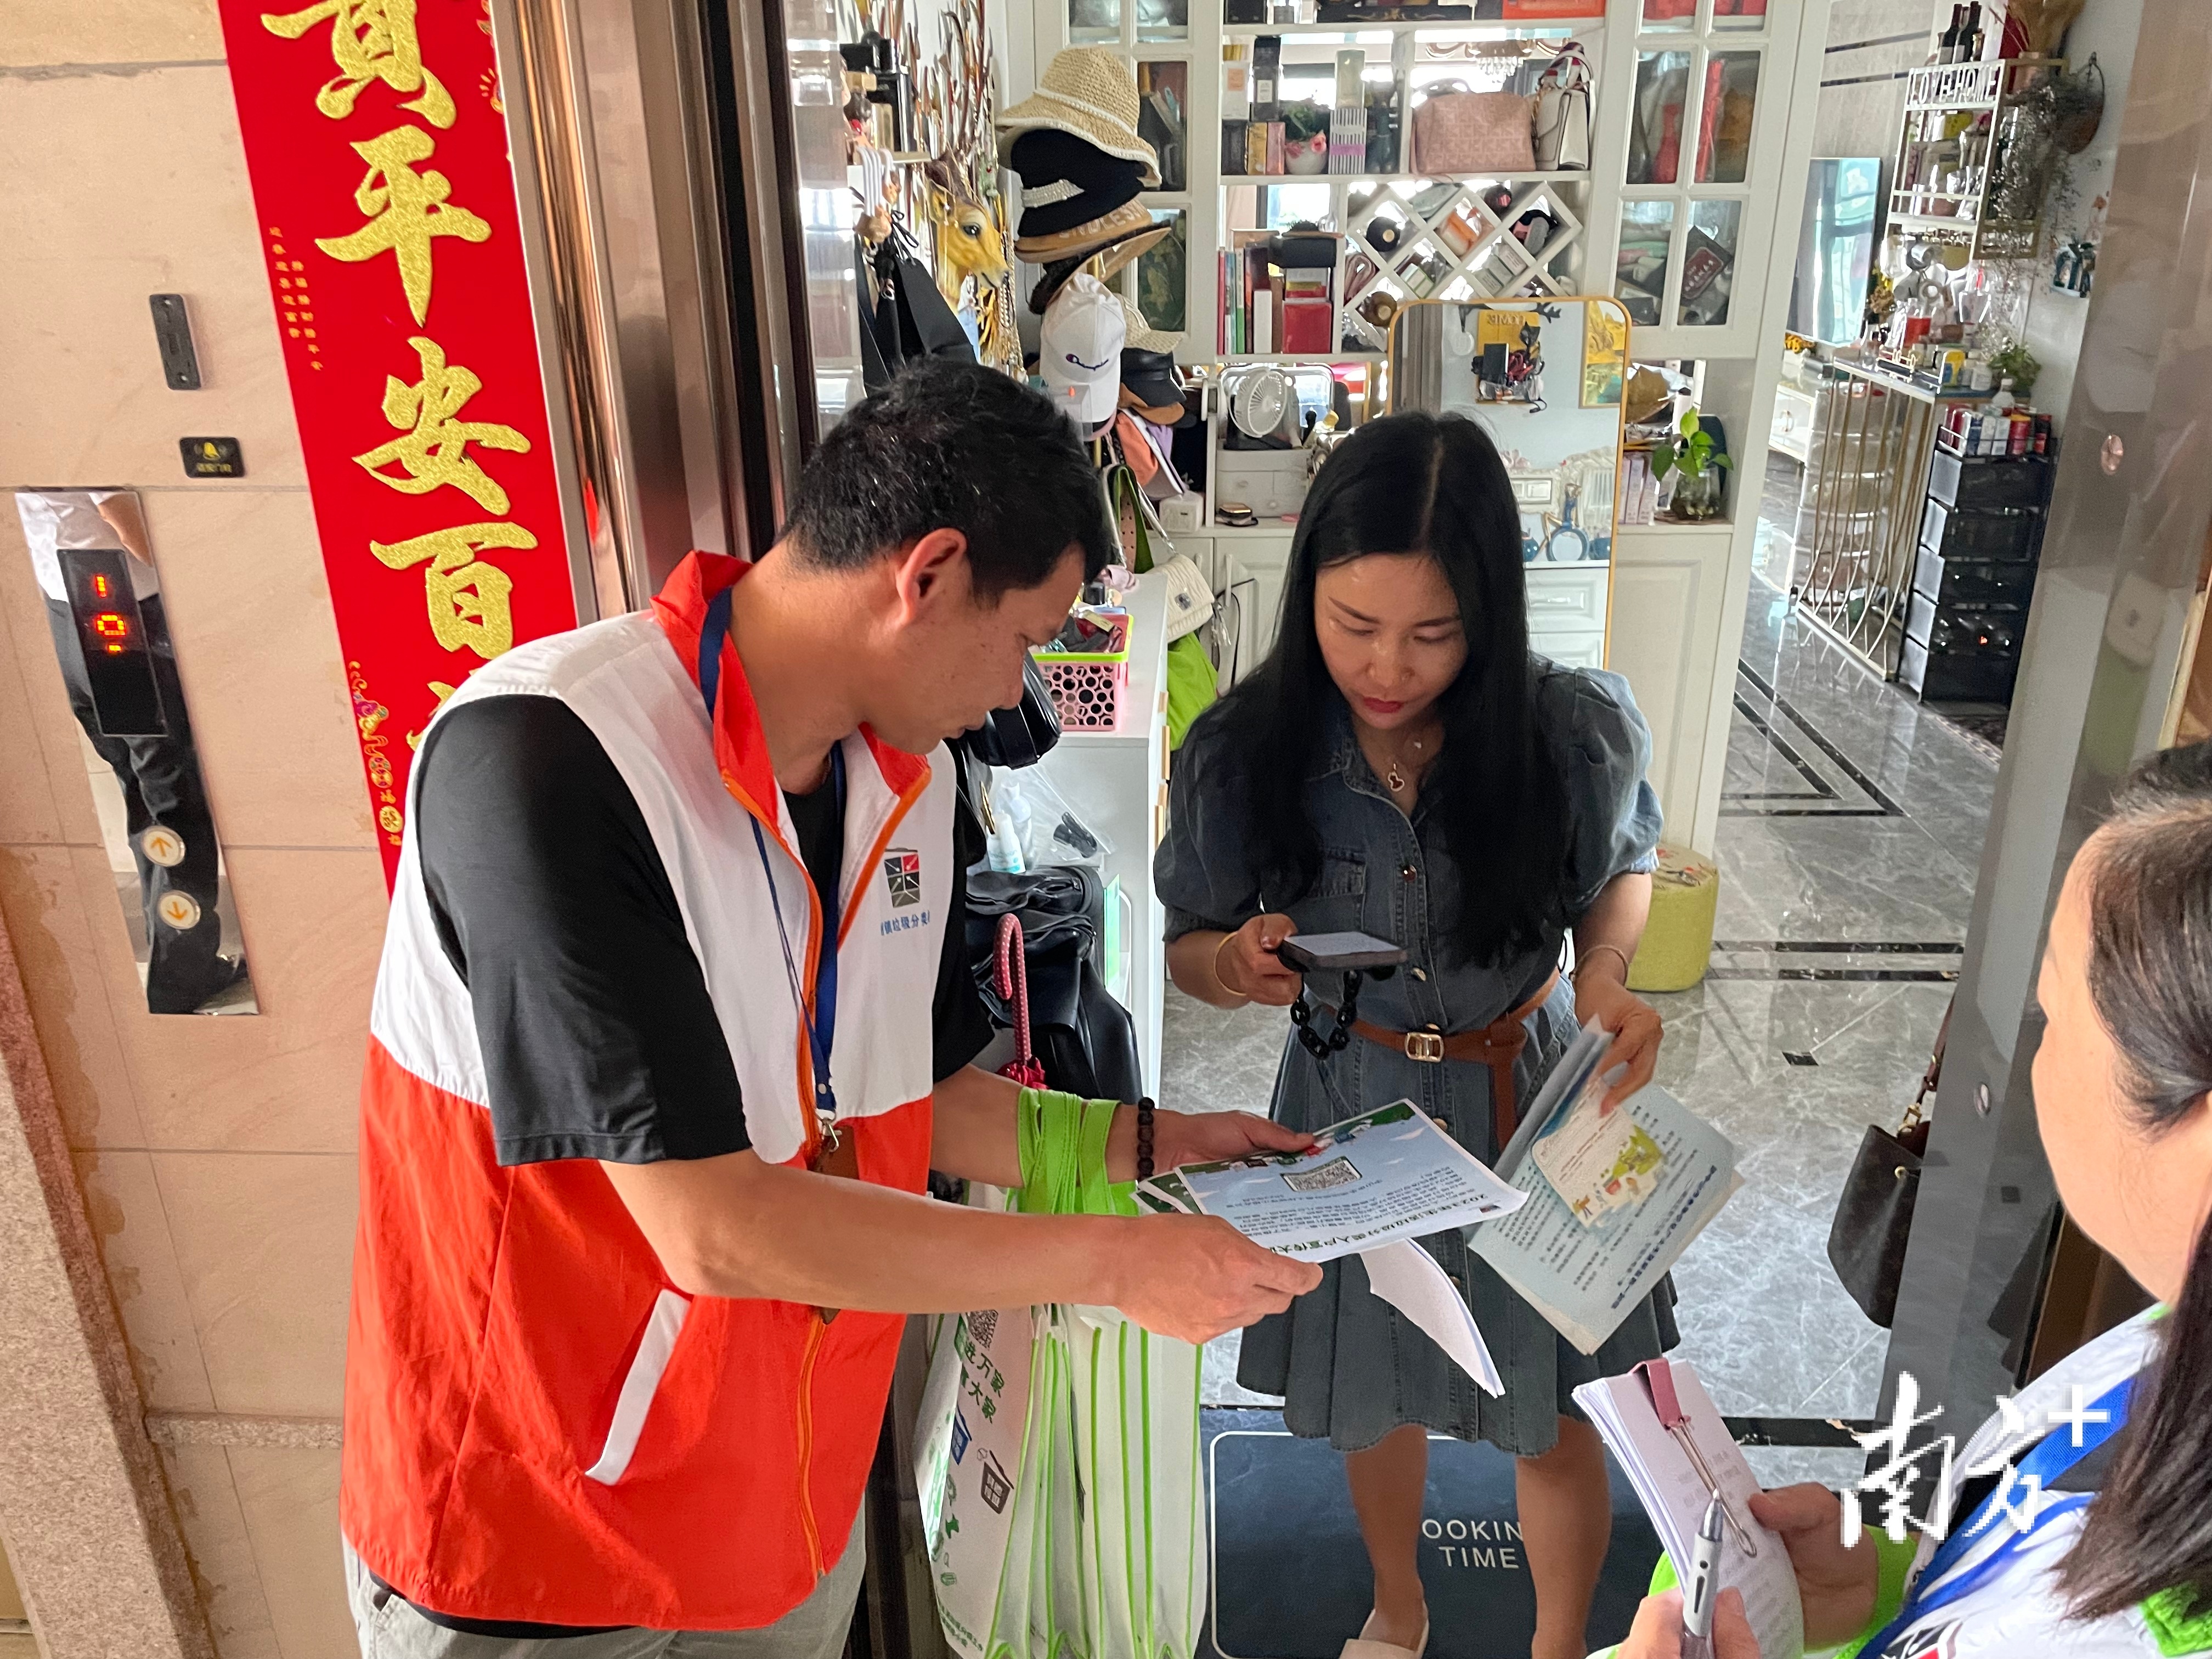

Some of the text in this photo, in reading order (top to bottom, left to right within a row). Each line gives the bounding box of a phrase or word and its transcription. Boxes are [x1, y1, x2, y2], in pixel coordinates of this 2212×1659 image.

[960, 1362, 996, 1425] 大家
[1422, 1519, 1523, 1543] OOKIN
[1438, 1546, 1519, 1569] TIME
